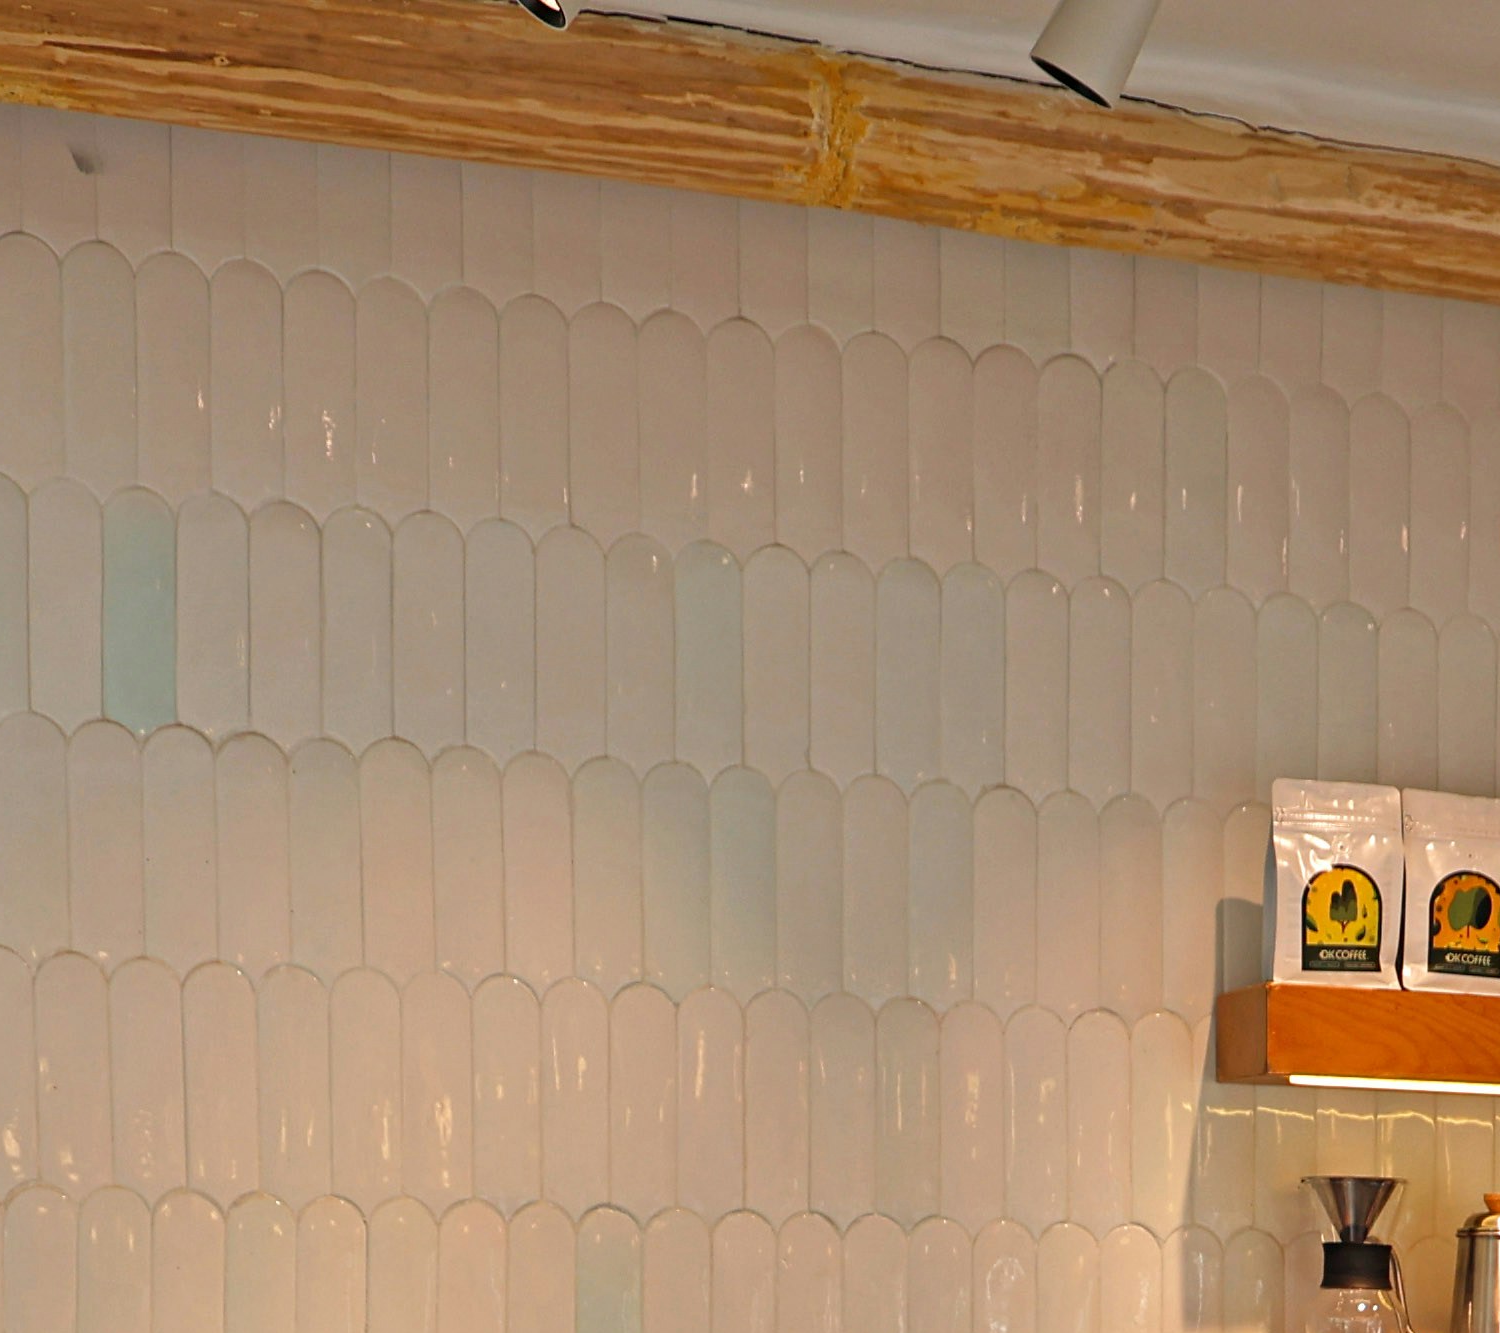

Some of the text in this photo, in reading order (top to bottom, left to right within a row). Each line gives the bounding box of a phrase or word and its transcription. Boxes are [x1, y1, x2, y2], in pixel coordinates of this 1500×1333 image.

[1319, 949, 1367, 960] OK COFFEE
[1445, 952, 1491, 966] OK COFFEE
